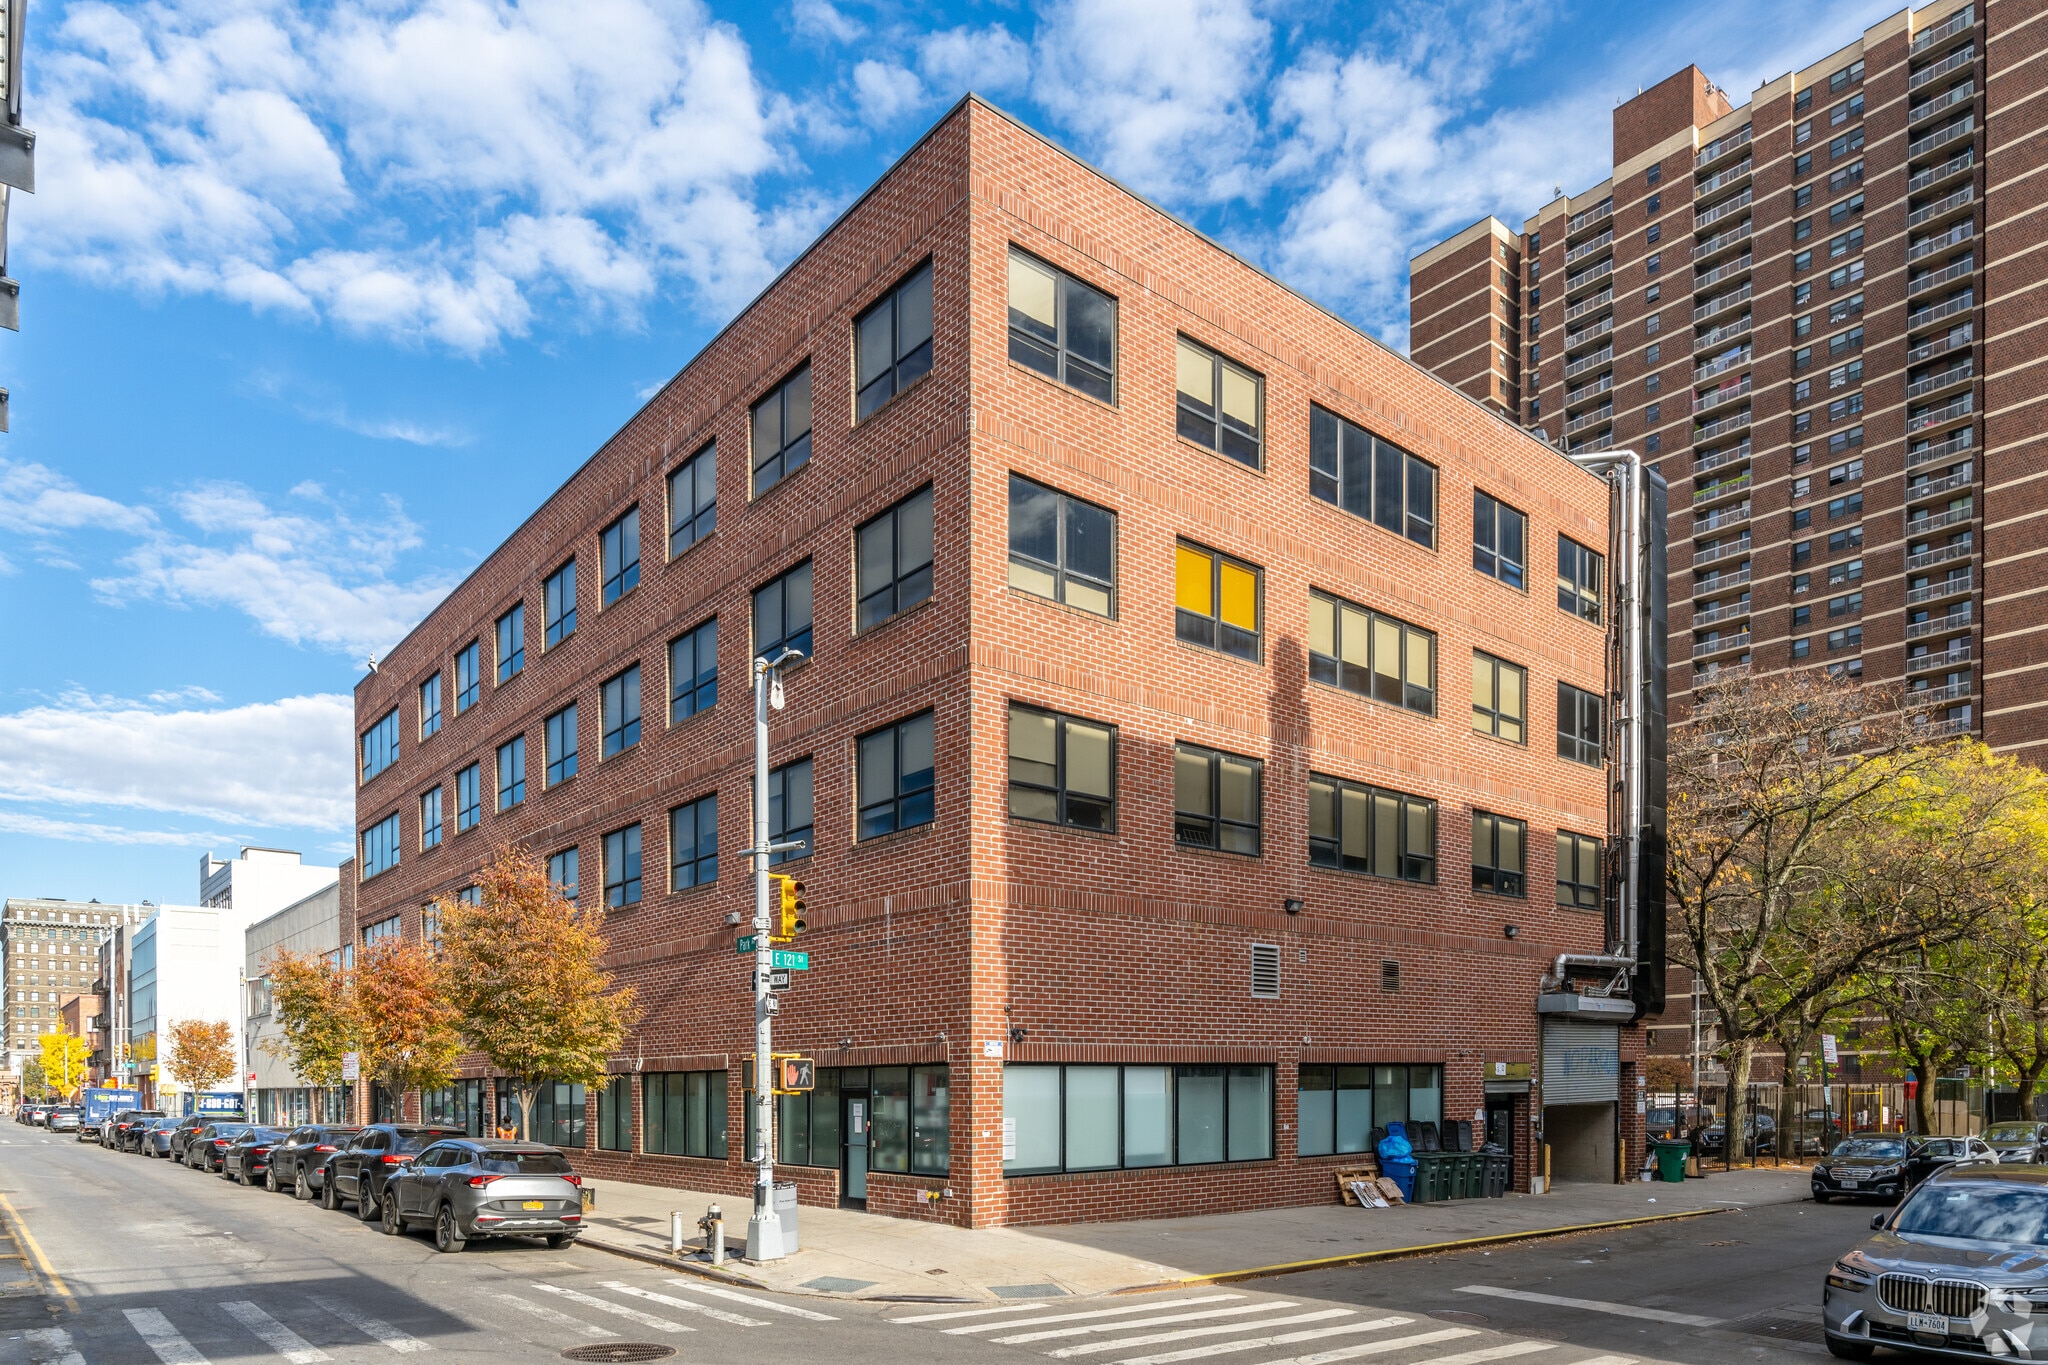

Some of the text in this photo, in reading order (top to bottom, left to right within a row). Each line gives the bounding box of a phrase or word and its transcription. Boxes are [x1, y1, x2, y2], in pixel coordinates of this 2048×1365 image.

[739, 939, 750, 951] Park
[775, 952, 780, 965] E
[784, 954, 795, 967] 121
[773, 975, 786, 984] WAY
[1910, 1317, 1945, 1331] LLM-7604
